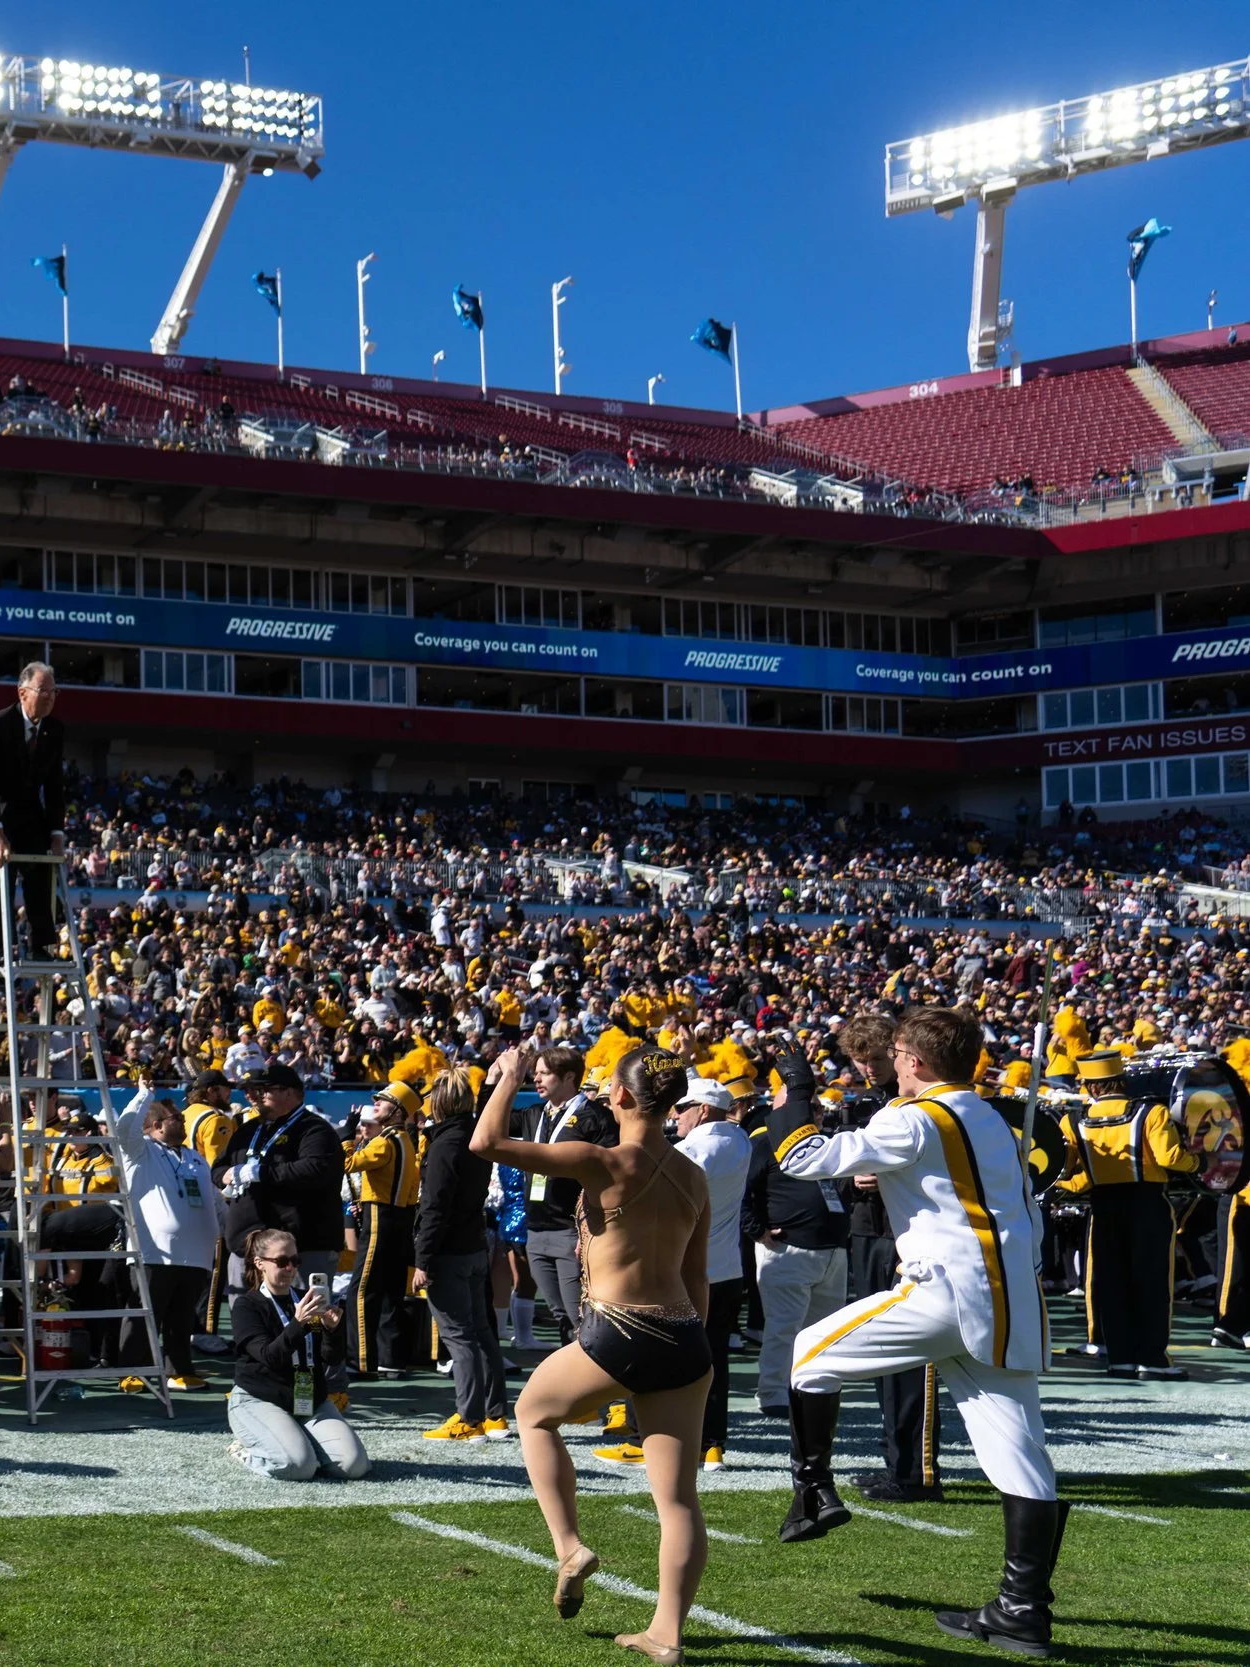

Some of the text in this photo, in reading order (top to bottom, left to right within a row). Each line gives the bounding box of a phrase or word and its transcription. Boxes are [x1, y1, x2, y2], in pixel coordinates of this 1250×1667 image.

[163, 356, 185, 369] 307
[909, 382, 938, 398] 304
[6, 607, 34, 621] you
[37, 609, 64, 621] can
[69, 610, 112, 625] count
[117, 613, 135, 626] on
[226, 617, 335, 642] PROGRESSIVE
[414, 632, 598, 658] Coverage you can count on
[1172, 637, 1250, 663] PROGR
[685, 650, 781, 673] PROGRESSIVE
[856, 661, 1052, 684] Coverage you can count on
[1044, 725, 1247, 757] TEXT FAN ISSUES
